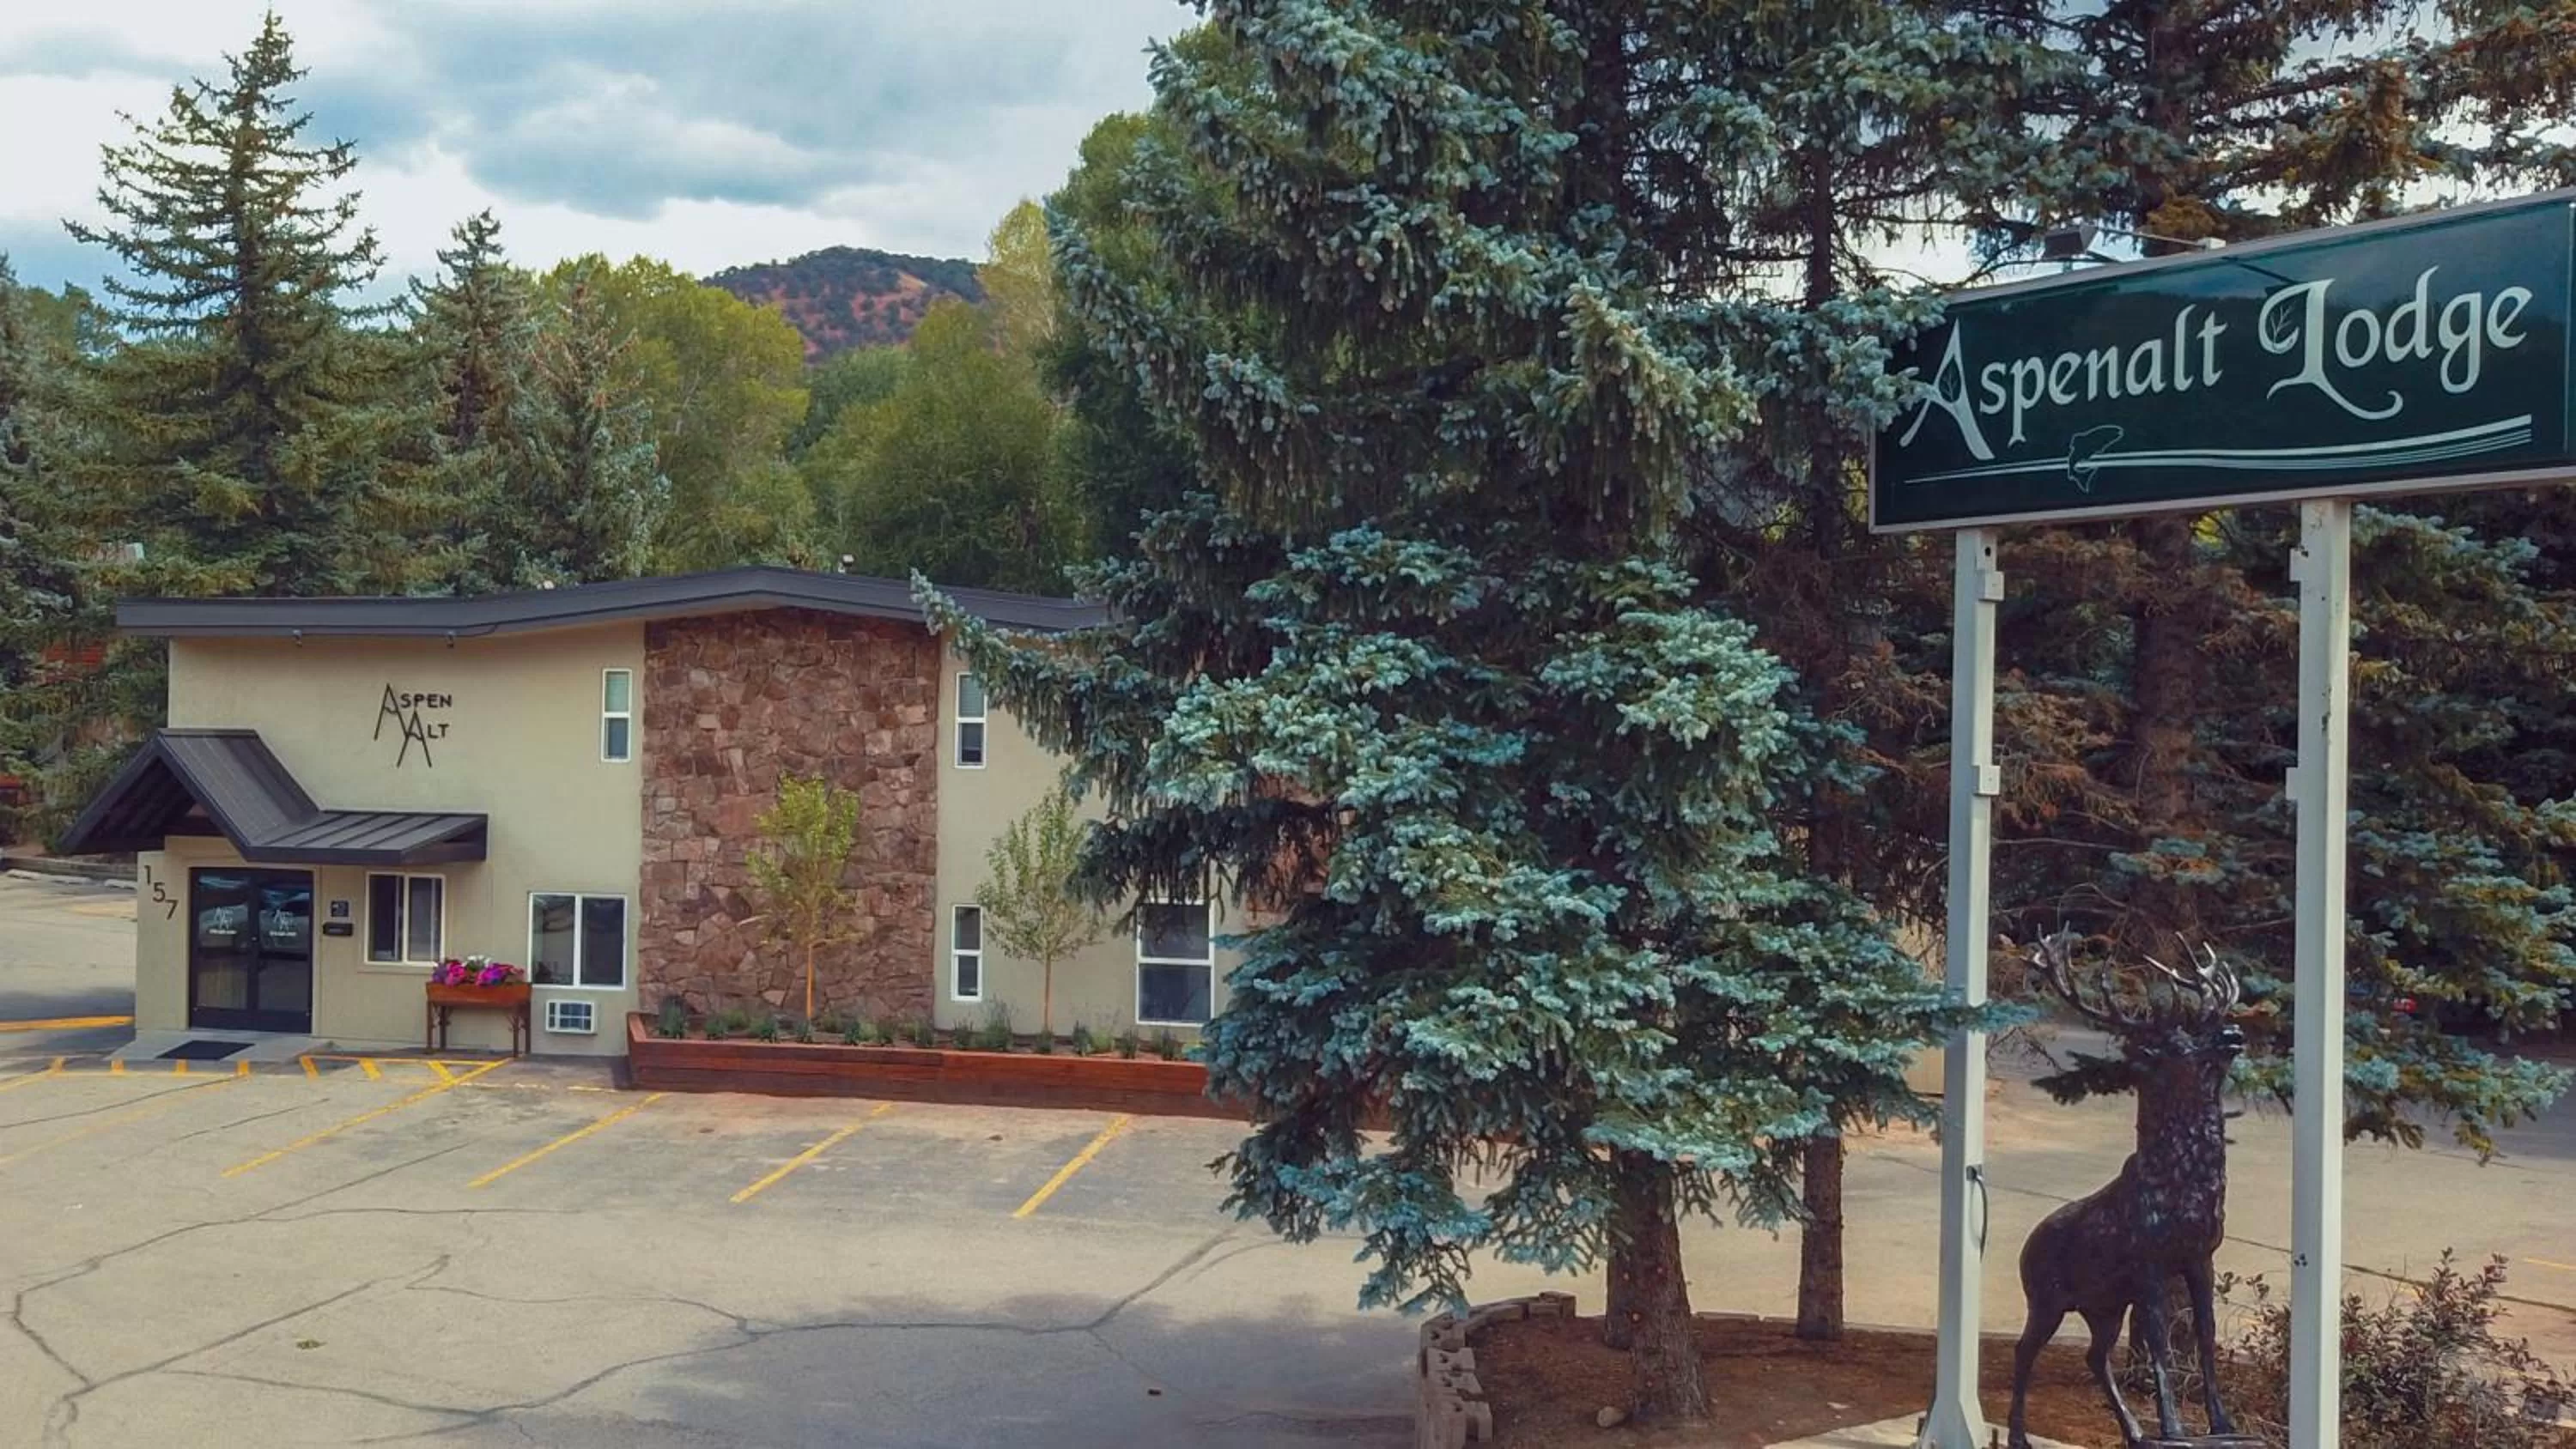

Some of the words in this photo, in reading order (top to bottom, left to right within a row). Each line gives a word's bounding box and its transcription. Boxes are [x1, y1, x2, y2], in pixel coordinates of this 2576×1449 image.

[1899, 303, 2229, 460] Aspenalt
[2258, 264, 2534, 420] Lodge
[374, 682, 453, 741] ASPEN
[396, 709, 450, 768] ALT
[143, 864, 179, 921] 157
